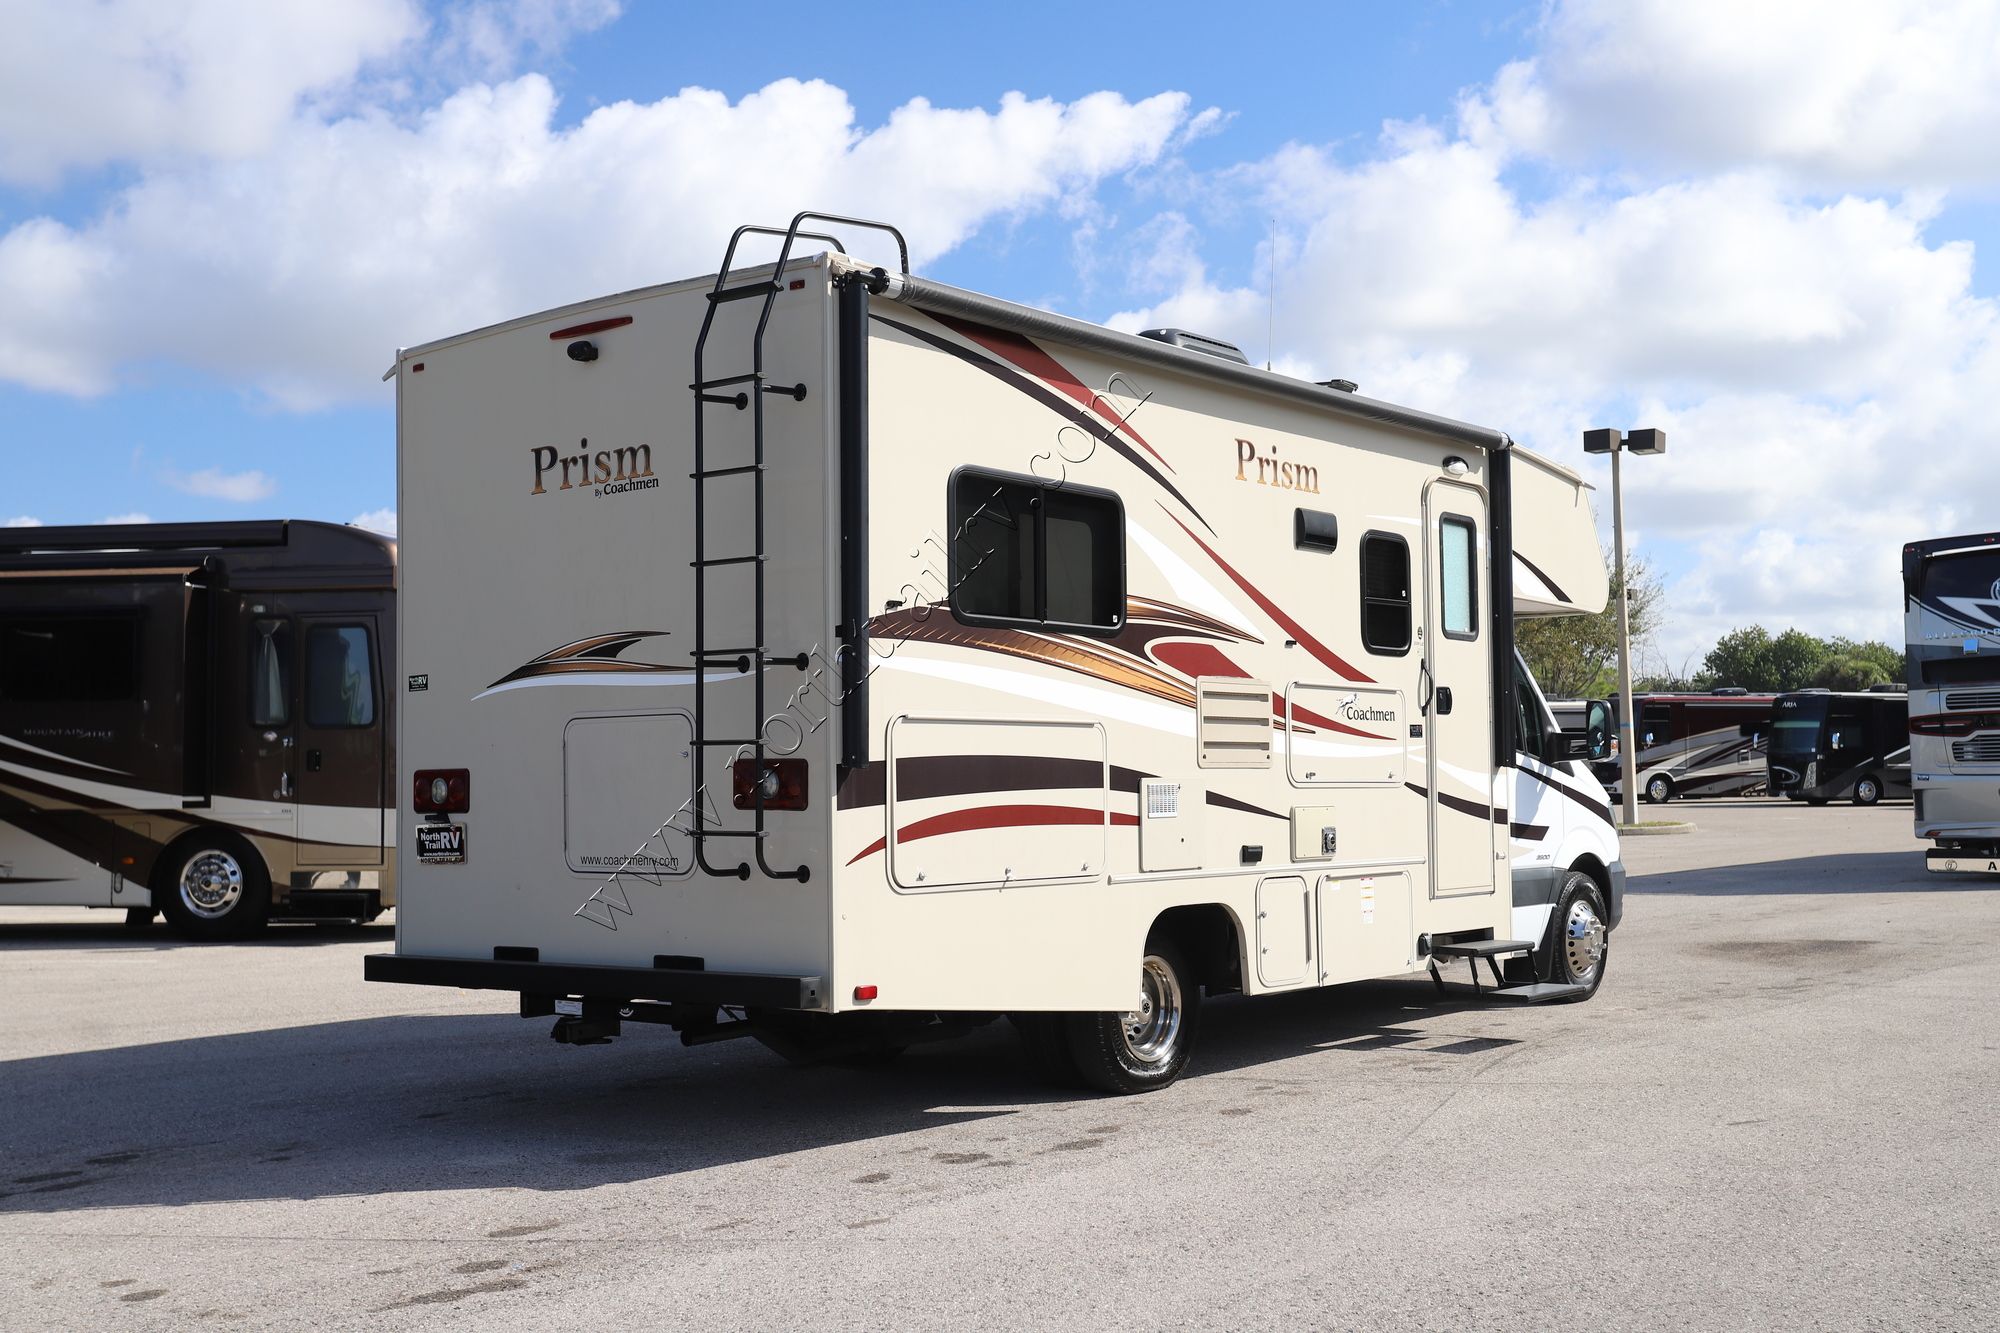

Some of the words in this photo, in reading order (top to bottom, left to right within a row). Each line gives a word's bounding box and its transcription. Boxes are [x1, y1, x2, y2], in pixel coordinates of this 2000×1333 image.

[530, 437, 654, 495] Prism
[1234, 438, 1320, 494] Prism
[594, 489, 602, 498] By
[603, 478, 659, 495] Coachmen
[1346, 706, 1396, 721] Coachmen
[420, 832, 440, 841] North
[424, 840, 441, 849] Trail
[440, 831, 460, 849] RV
